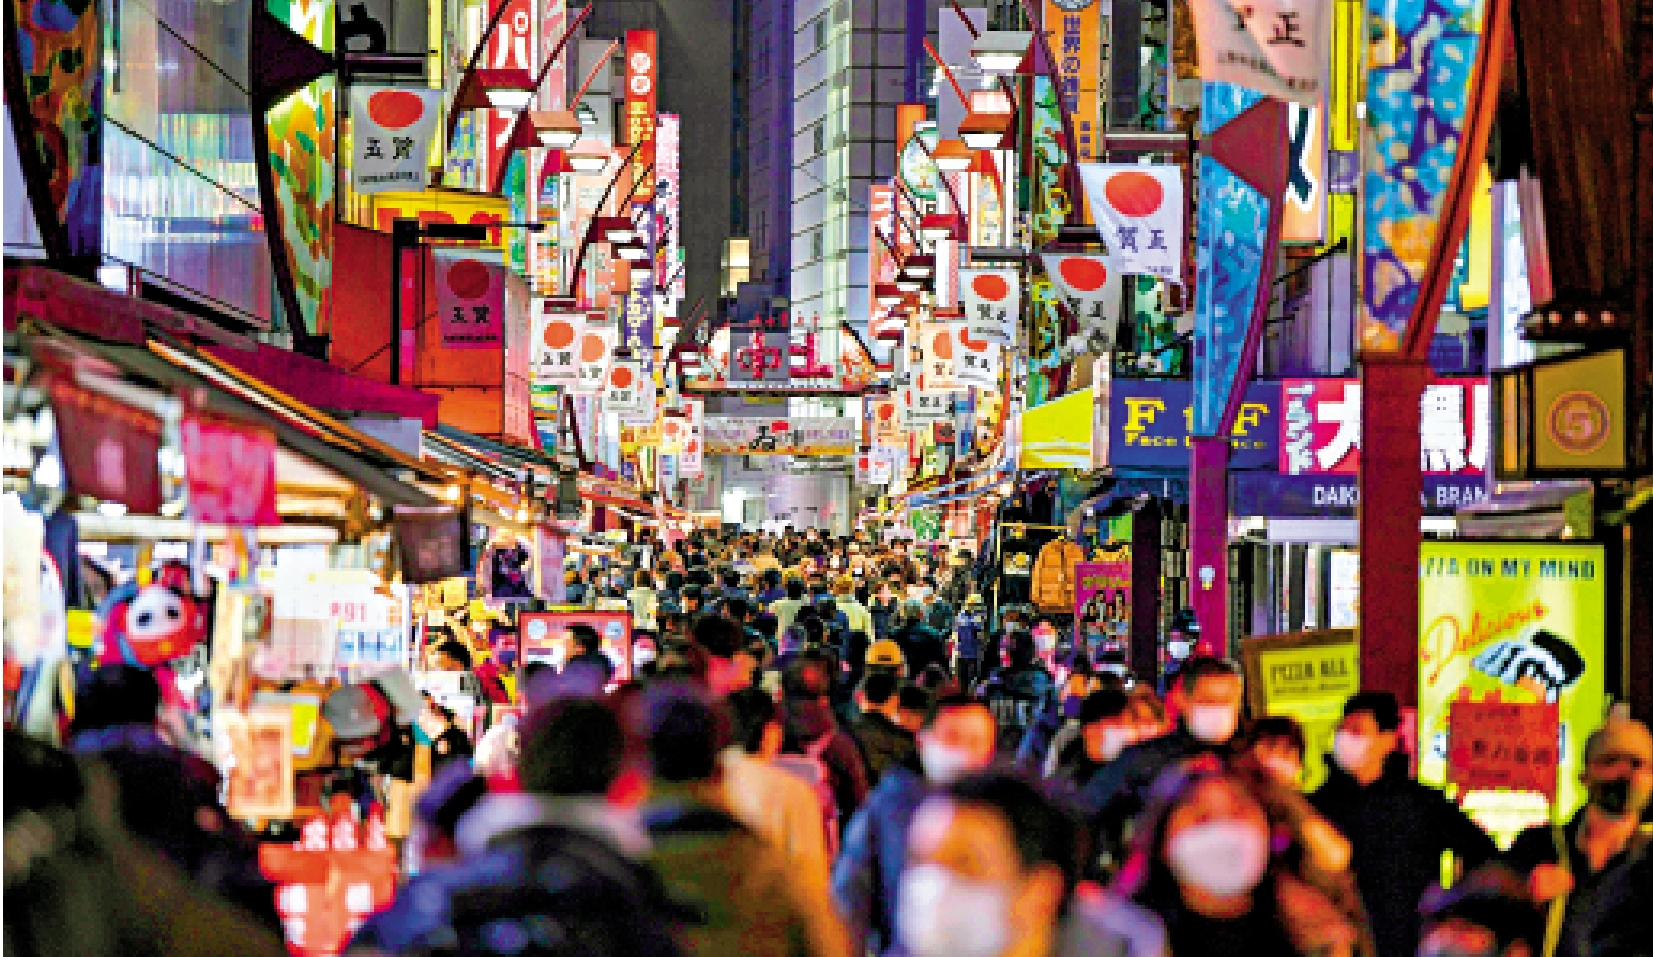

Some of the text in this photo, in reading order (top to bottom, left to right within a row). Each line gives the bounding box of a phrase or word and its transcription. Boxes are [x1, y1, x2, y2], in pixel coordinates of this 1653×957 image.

[1314, 486, 1361, 505] DAIK
[1466, 558, 1494, 577] ON
[1501, 558, 1531, 578] MY
[1539, 558, 1595, 580] MIND
